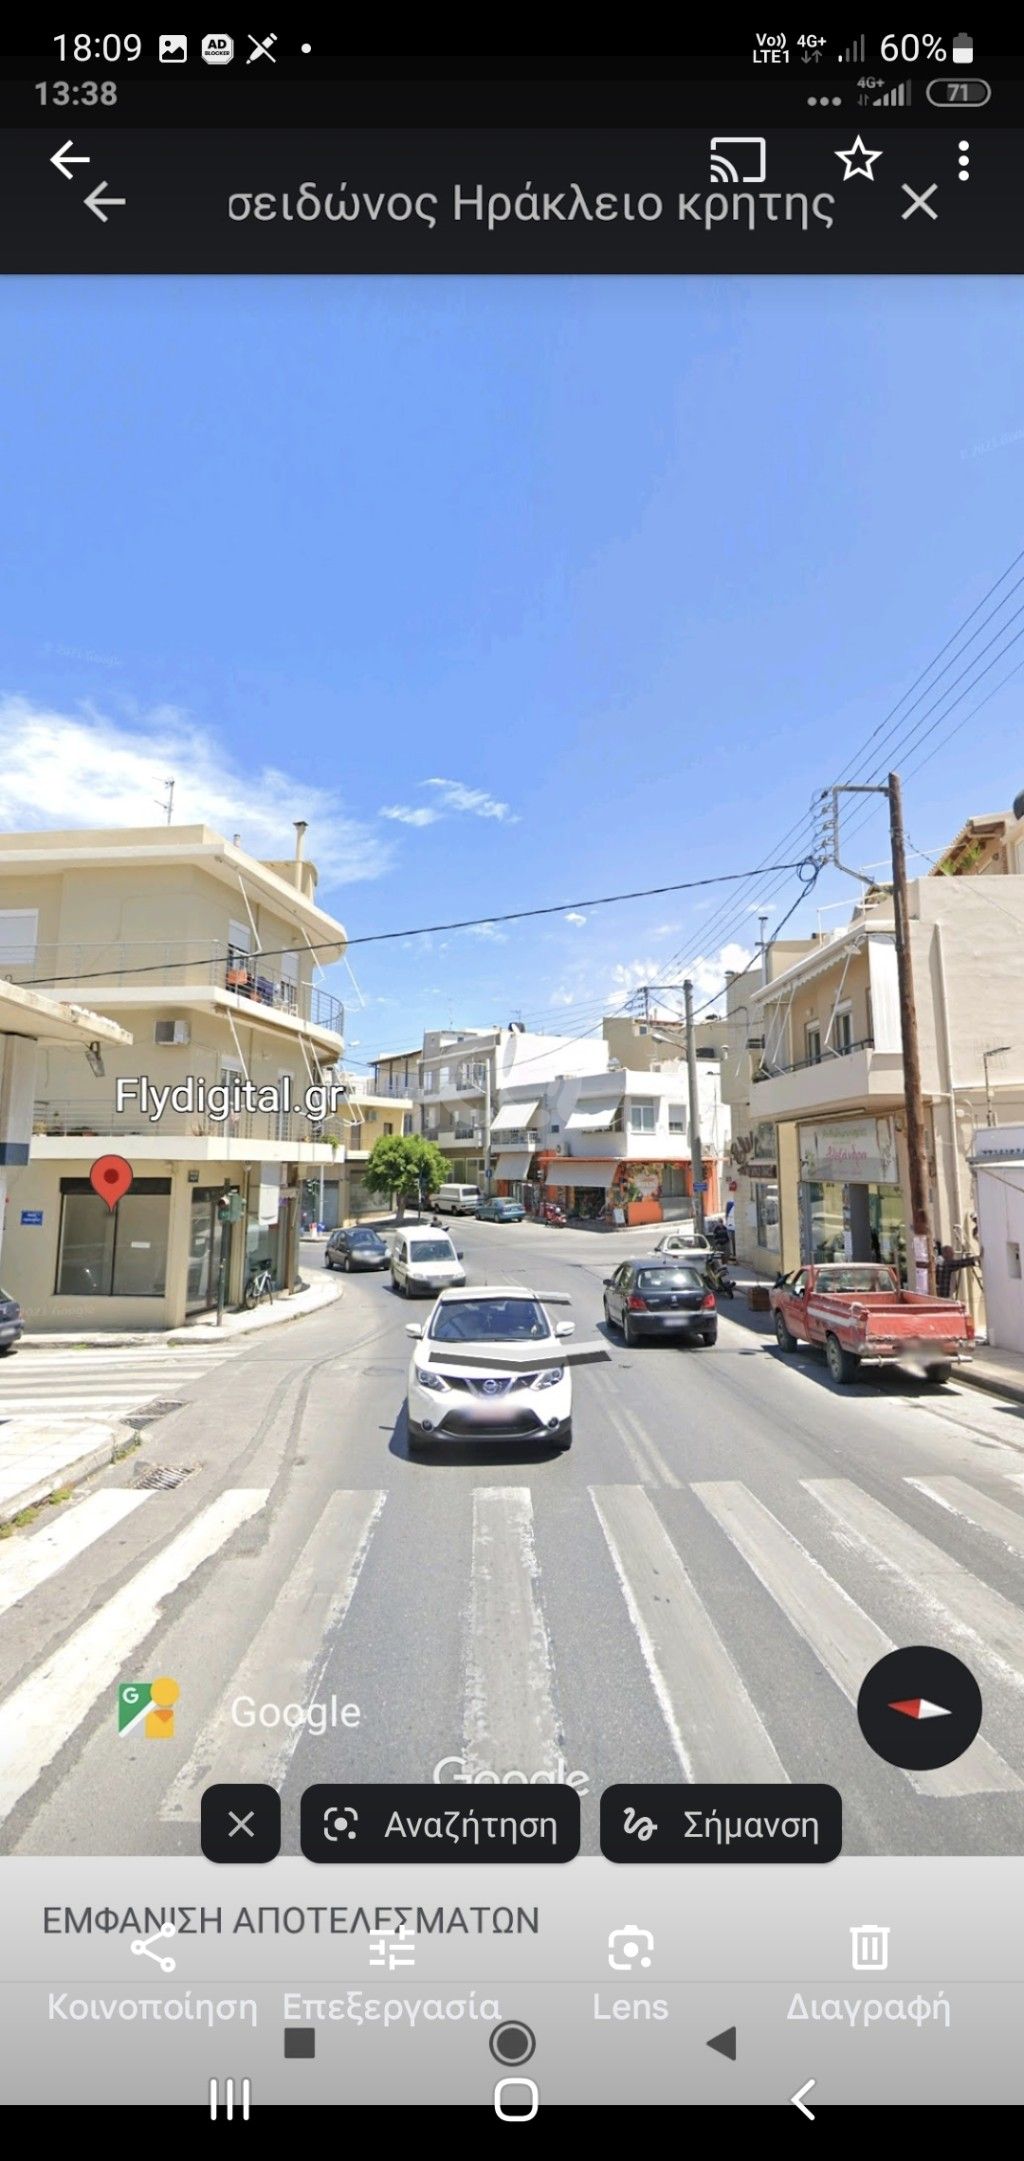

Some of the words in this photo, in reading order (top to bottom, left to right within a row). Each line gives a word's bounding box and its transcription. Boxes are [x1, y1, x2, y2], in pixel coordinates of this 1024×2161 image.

[53, 33, 142, 62] 18:09
[207, 39, 227, 49] AD
[796, 34, 827, 48] 4G+
[880, 33, 947, 62] 60%
[753, 49, 790, 64] LTE1
[35, 80, 118, 106] 13:38
[856, 76, 885, 89] 4G+
[947, 83, 969, 102] 71
[454, 181, 663, 231] Ηράκλειο
[678, 191, 835, 231] κρητης
[384, 1808, 557, 1845] Αναζήτηση
[684, 1808, 819, 1845] Σήμανση
[44, 1905, 222, 1935] ΕΜΦΑΝΙΣΗ
[233, 1906, 539, 1935] ΑΠΟΤΕΛΕΣΜΑΤΩΝ
[48, 1991, 257, 2027] Κοινοποίηση
[284, 1990, 503, 2027] Επεξεργασία
[593, 1992, 669, 2020] Lens
[786, 1990, 951, 2027] Διαγραφή
